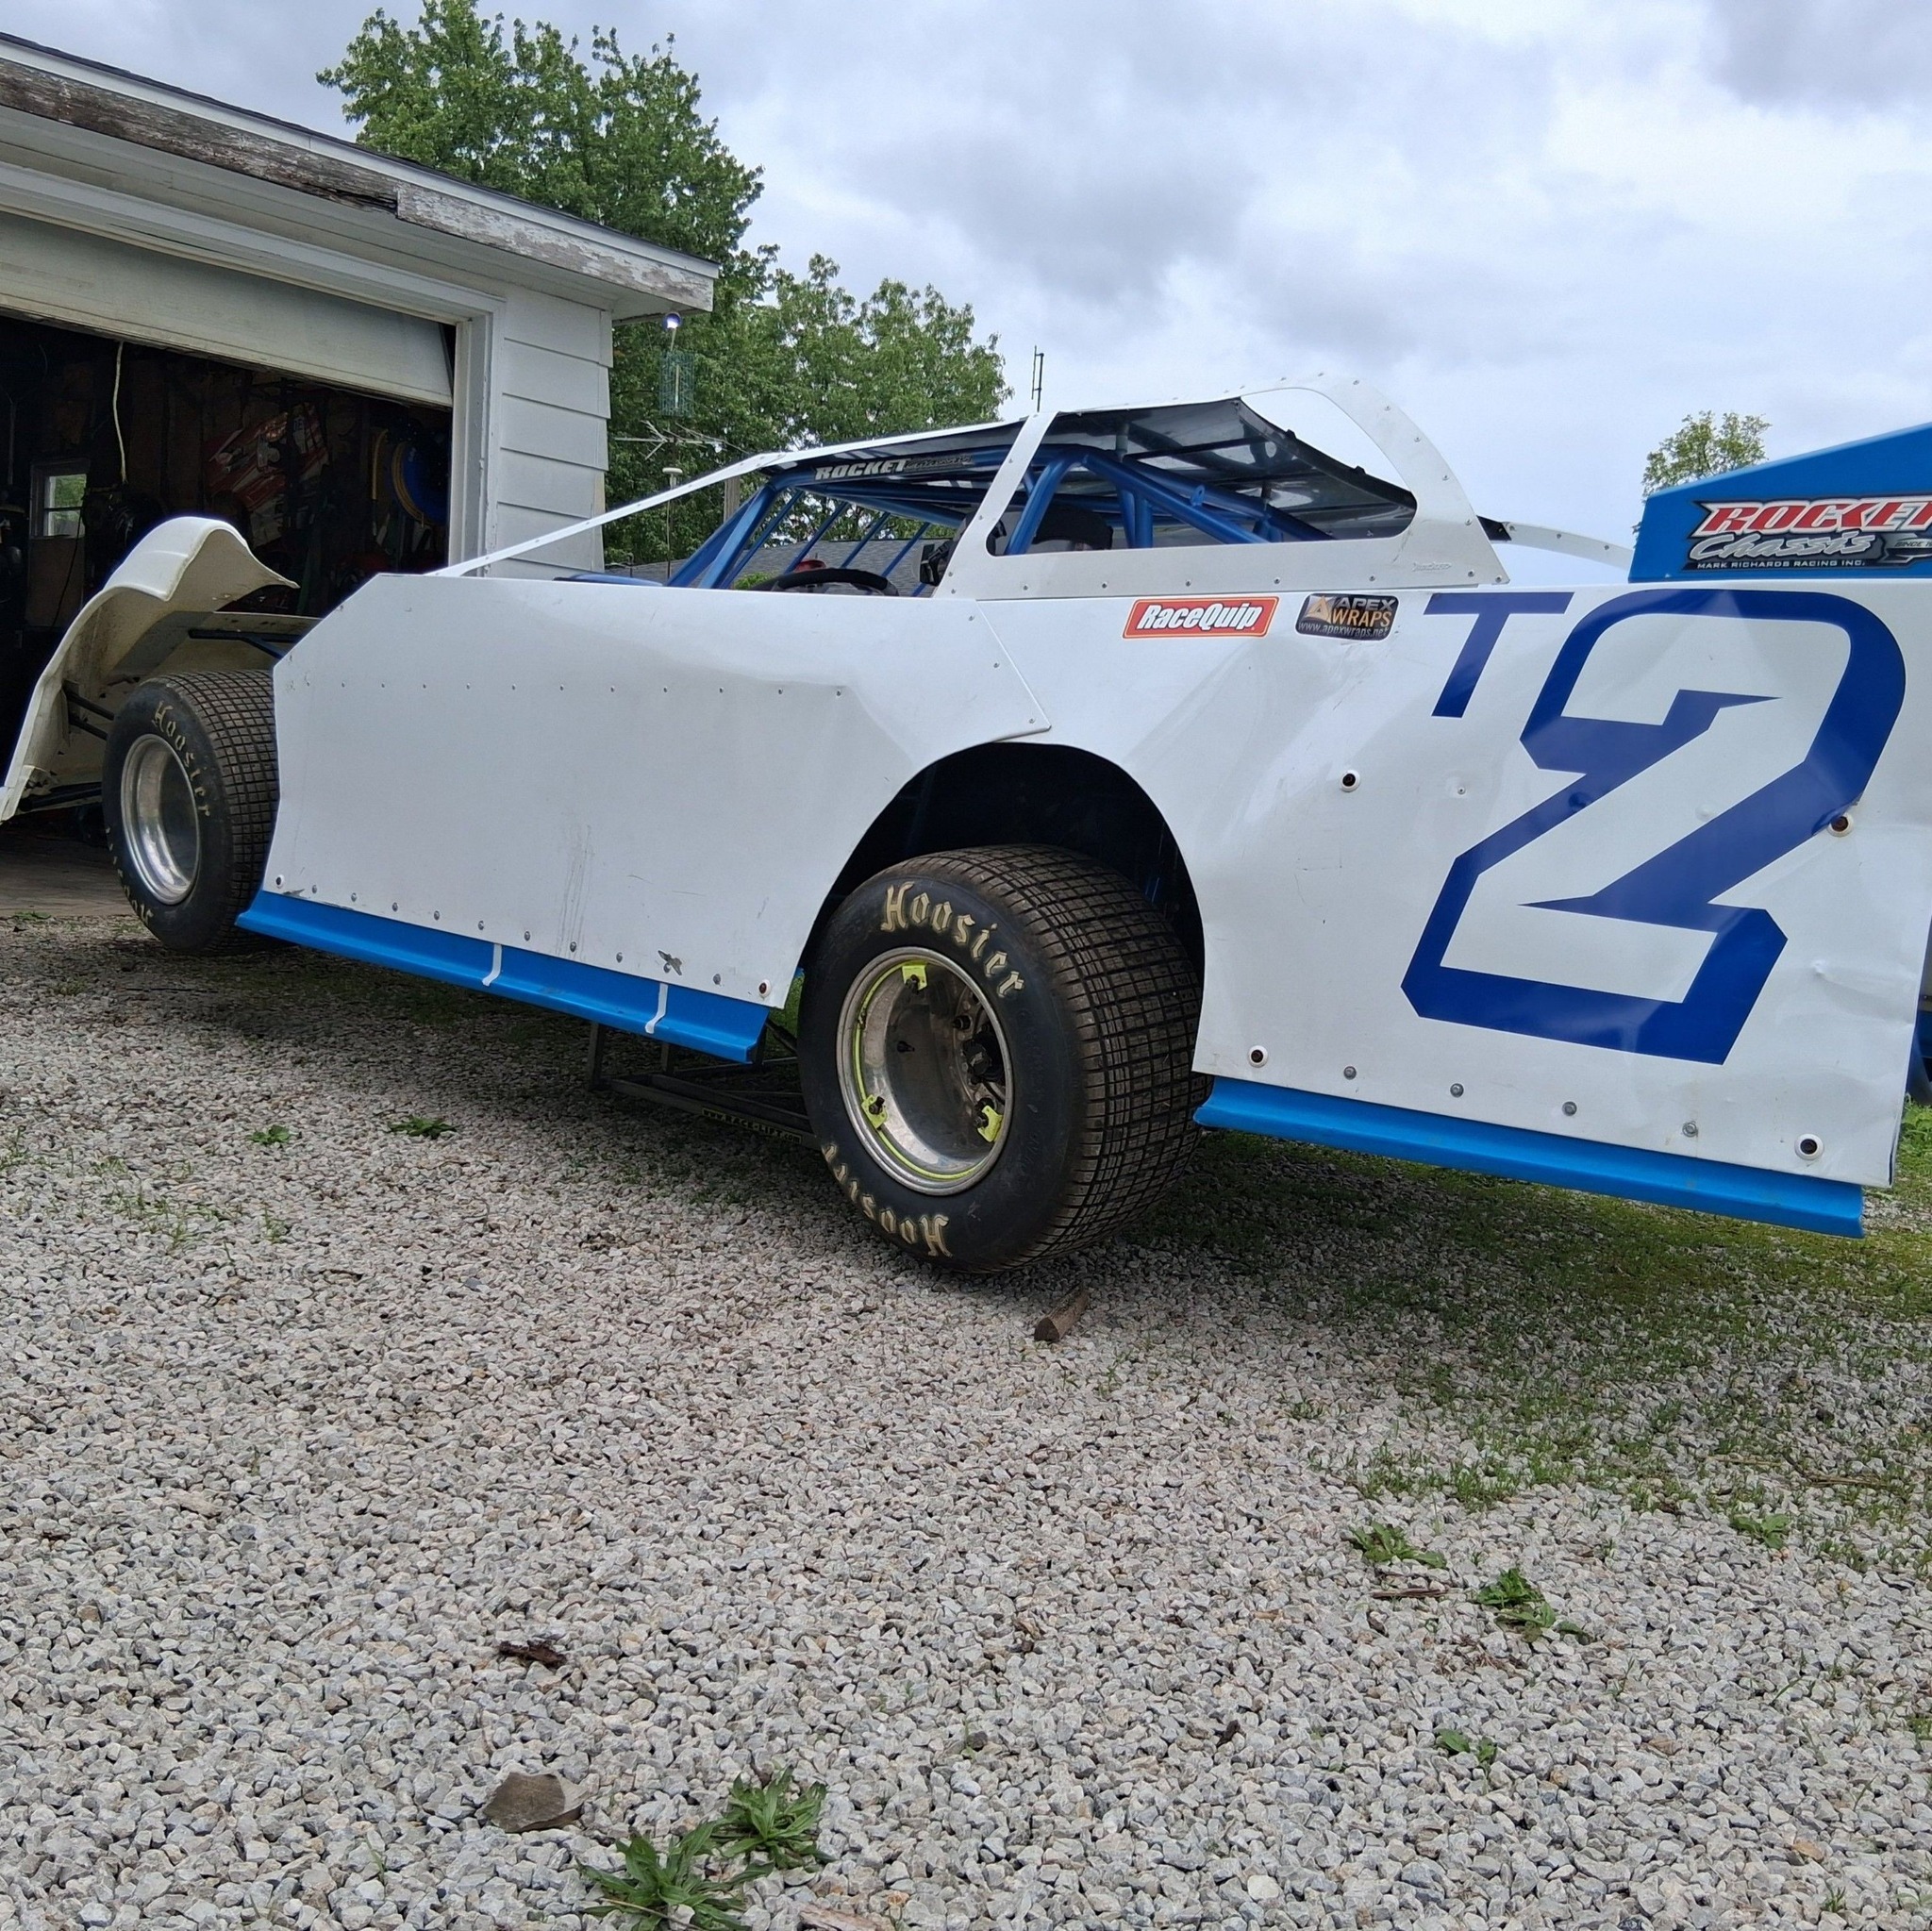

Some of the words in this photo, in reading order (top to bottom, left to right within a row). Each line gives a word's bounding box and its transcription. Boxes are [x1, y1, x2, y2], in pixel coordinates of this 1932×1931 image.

[815, 458, 911, 481] ROCKET
[1690, 530, 1875, 561] Chassis
[1335, 596, 1395, 611] APEX
[1137, 603, 1263, 630] RaceQuip
[1332, 608, 1392, 627] WRAPS
[1298, 622, 1391, 638] www.apexwraps.net
[1400, 589, 1907, 1065] 2
[880, 881, 1025, 998] Hoosier
